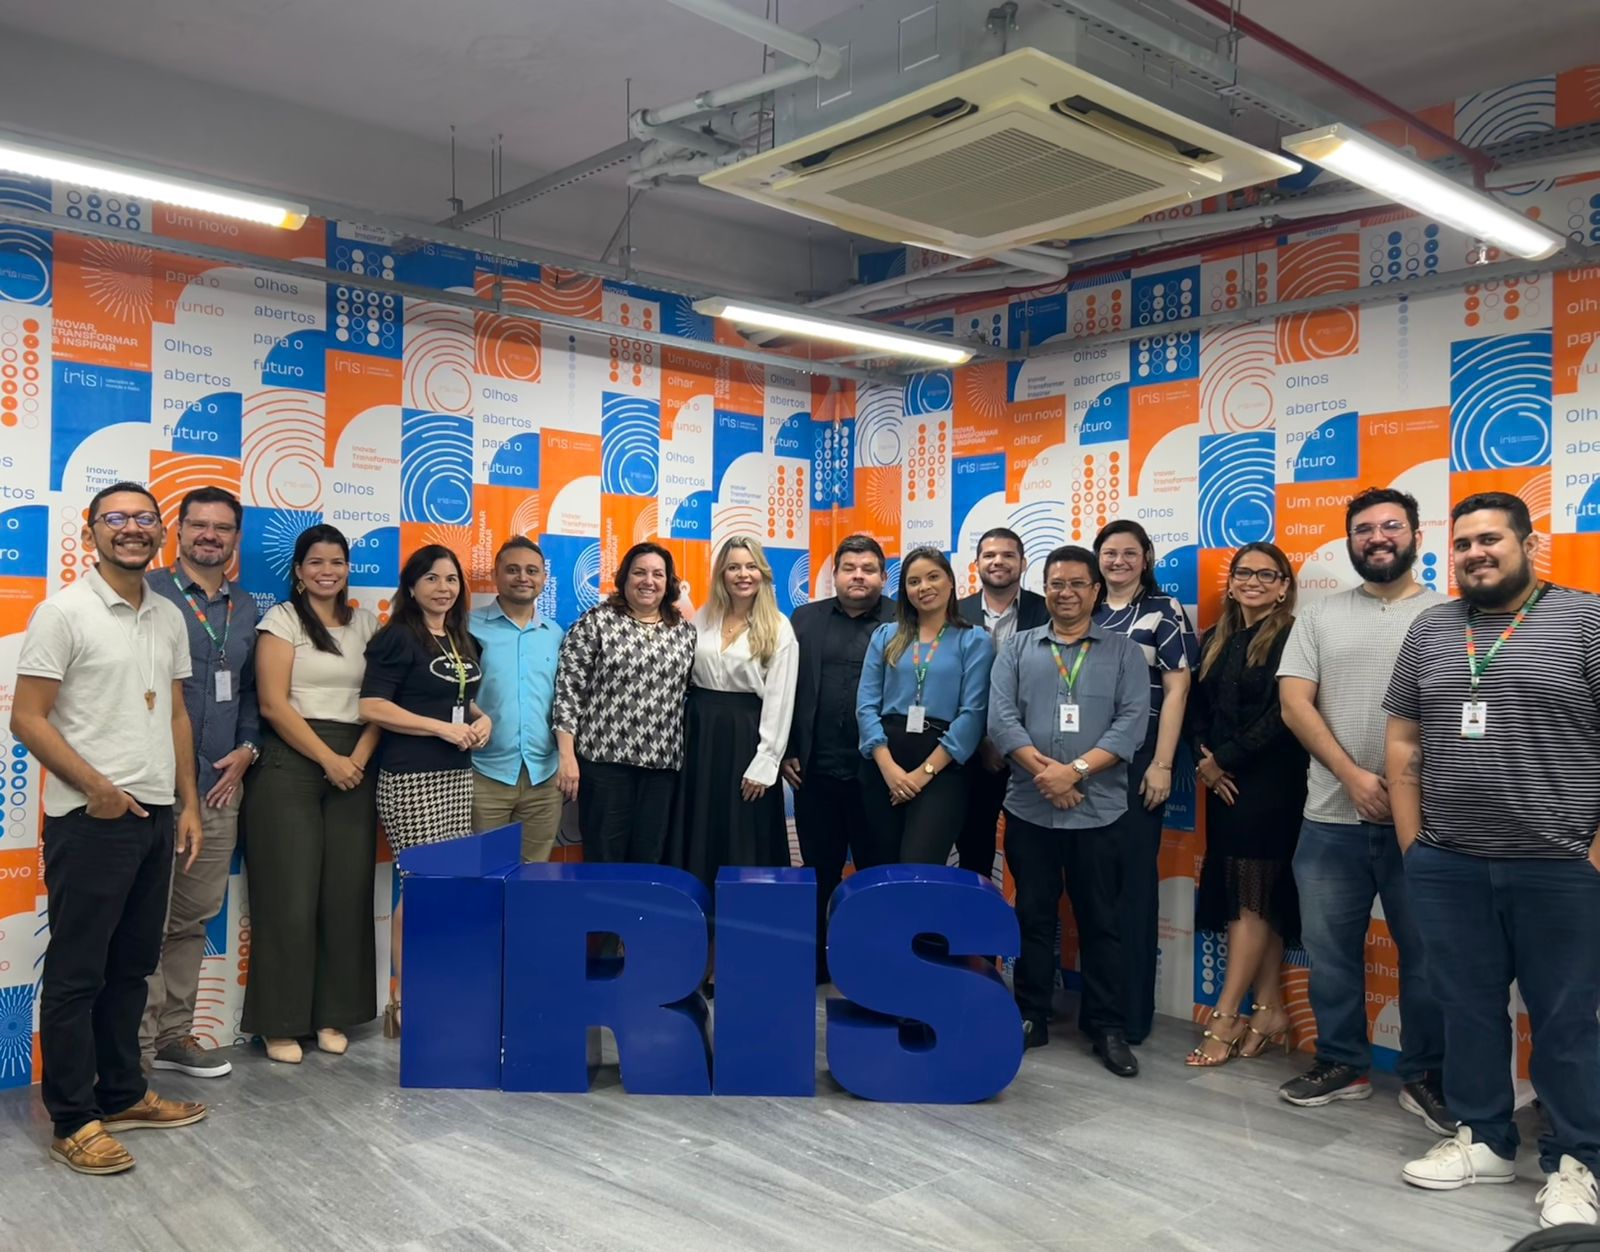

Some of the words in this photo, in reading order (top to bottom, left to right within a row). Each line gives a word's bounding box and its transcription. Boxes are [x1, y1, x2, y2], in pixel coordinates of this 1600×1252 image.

[165, 212, 194, 229] Um
[201, 219, 239, 237] novo
[165, 268, 204, 287] para
[211, 278, 221, 289] o
[254, 276, 299, 296] Olhos
[165, 298, 225, 318] mundo
[1567, 298, 1599, 314] olh
[254, 305, 316, 325] abertos
[52, 327, 139, 347] TRANSFORMAR
[254, 331, 289, 349] para
[294, 339, 304, 350] o
[1567, 331, 1600, 348] par
[63, 338, 117, 352] INSPIRAR
[164, 338, 213, 357] Olhos
[668, 353, 685, 365] Um
[688, 356, 712, 370] novo
[1073, 347, 1108, 363] Olhos
[254, 358, 304, 377] futuro
[335, 357, 361, 374] iris
[63, 367, 97, 387] iris
[164, 367, 231, 388] abertos
[668, 375, 695, 389] olhar
[770, 373, 796, 387] Olhos
[1073, 370, 1121, 386] abertos
[1286, 372, 1329, 389] Olhos
[482, 388, 518, 403] Olhos
[770, 394, 806, 409] abertos
[1137, 390, 1160, 406] iris
[163, 396, 203, 413] para
[207, 402, 218, 414] o
[667, 398, 690, 411] para
[1073, 398, 1102, 411] para
[1103, 396, 1112, 407] o
[1286, 398, 1348, 416] abertos
[482, 413, 532, 429] abertos
[719, 414, 737, 430] iris
[769, 416, 790, 428] para
[792, 419, 799, 429] o
[1014, 412, 1032, 424] Um
[1035, 408, 1063, 421] novo
[163, 424, 218, 442] futuro
[1073, 419, 1112, 434] futuro
[1369, 420, 1399, 437] iris
[547, 436, 569, 450] iris
[769, 435, 799, 449] futuro
[1013, 433, 1042, 447] olhar
[1286, 429, 1321, 444] para
[1325, 427, 1335, 438] o
[482, 437, 511, 452] para
[514, 441, 523, 452] o
[666, 451, 695, 464] Olhos
[1013, 456, 1038, 469] para
[1041, 456, 1049, 467] o
[1286, 454, 1335, 470] futuro
[86, 465, 118, 476] Inovar
[482, 460, 522, 476] futuro
[957, 461, 976, 474] iris
[665, 474, 706, 487] abertos
[1013, 478, 1052, 491] mundo
[1566, 472, 1600, 487] par
[333, 481, 375, 496] Olhos
[665, 497, 689, 509] para
[691, 497, 698, 508] o
[1286, 497, 1311, 510] Um
[333, 508, 390, 523] abertos
[1137, 506, 1174, 520] Olhos
[6, 518, 19, 530] o
[665, 517, 698, 530] futuro
[906, 518, 934, 530] Olhos
[1285, 523, 1325, 536] olhar
[346, 537, 367, 549] ara
[370, 537, 379, 549] o
[1148, 531, 1189, 543] ertos
[1170, 557, 1179, 569] o
[1285, 550, 1320, 563] para
[1324, 551, 1334, 562] o
[349, 562, 380, 575] turo
[1300, 577, 1338, 590] undo
[249, 592, 276, 602] OVAR,
[0, 866, 31, 880] ovo
[1365, 931, 1392, 947] Um
[1365, 963, 1399, 979] olha
